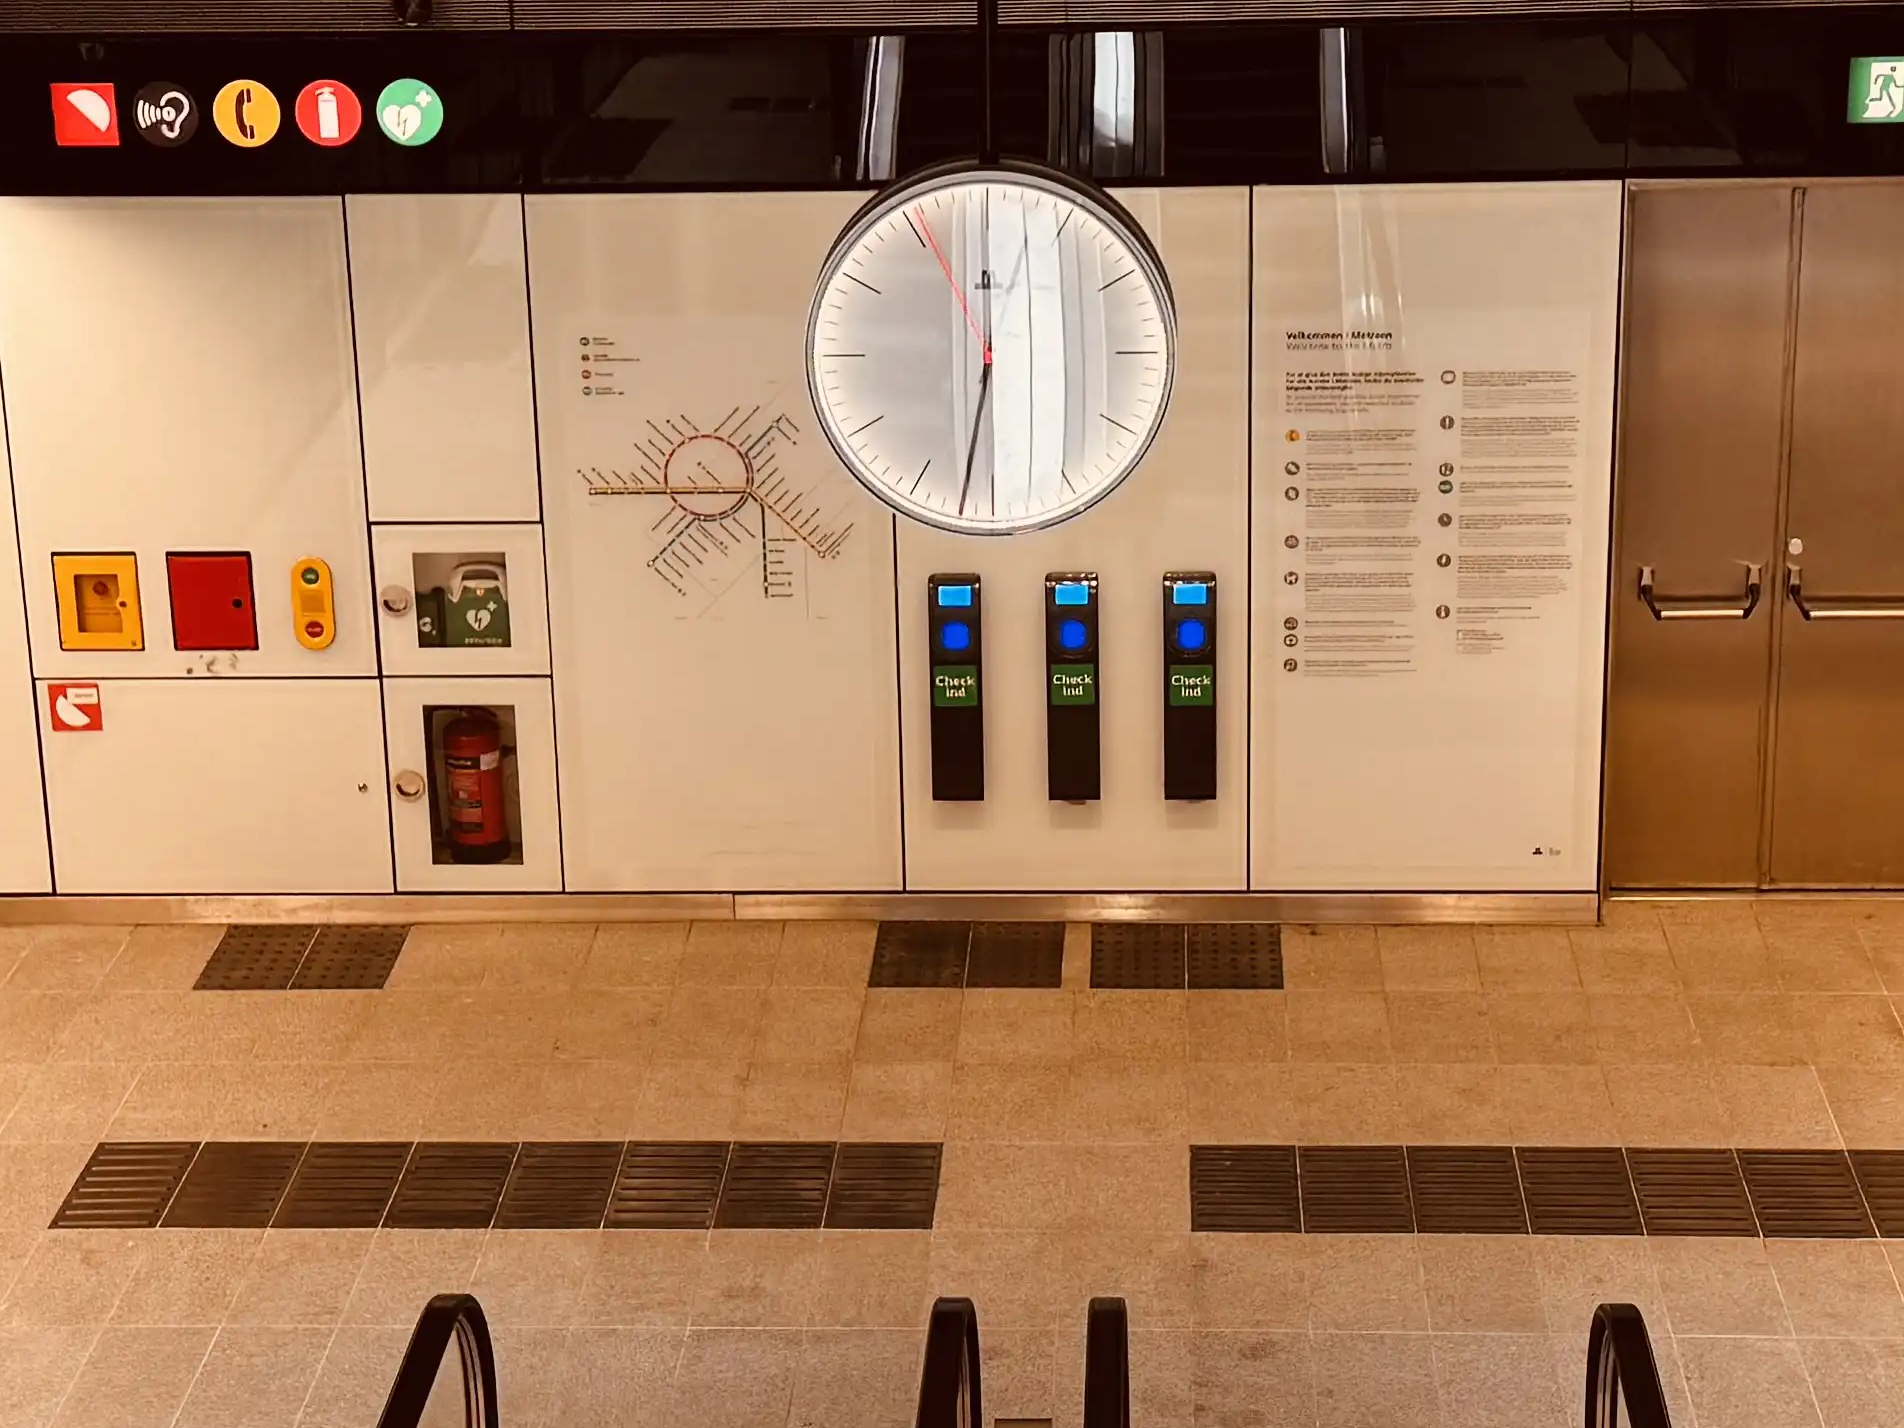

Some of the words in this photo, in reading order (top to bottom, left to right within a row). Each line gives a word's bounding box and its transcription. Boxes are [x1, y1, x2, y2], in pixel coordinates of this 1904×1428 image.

[935, 675, 975, 687] Check
[1052, 673, 1093, 685] Check
[1171, 674, 1211, 686] Check
